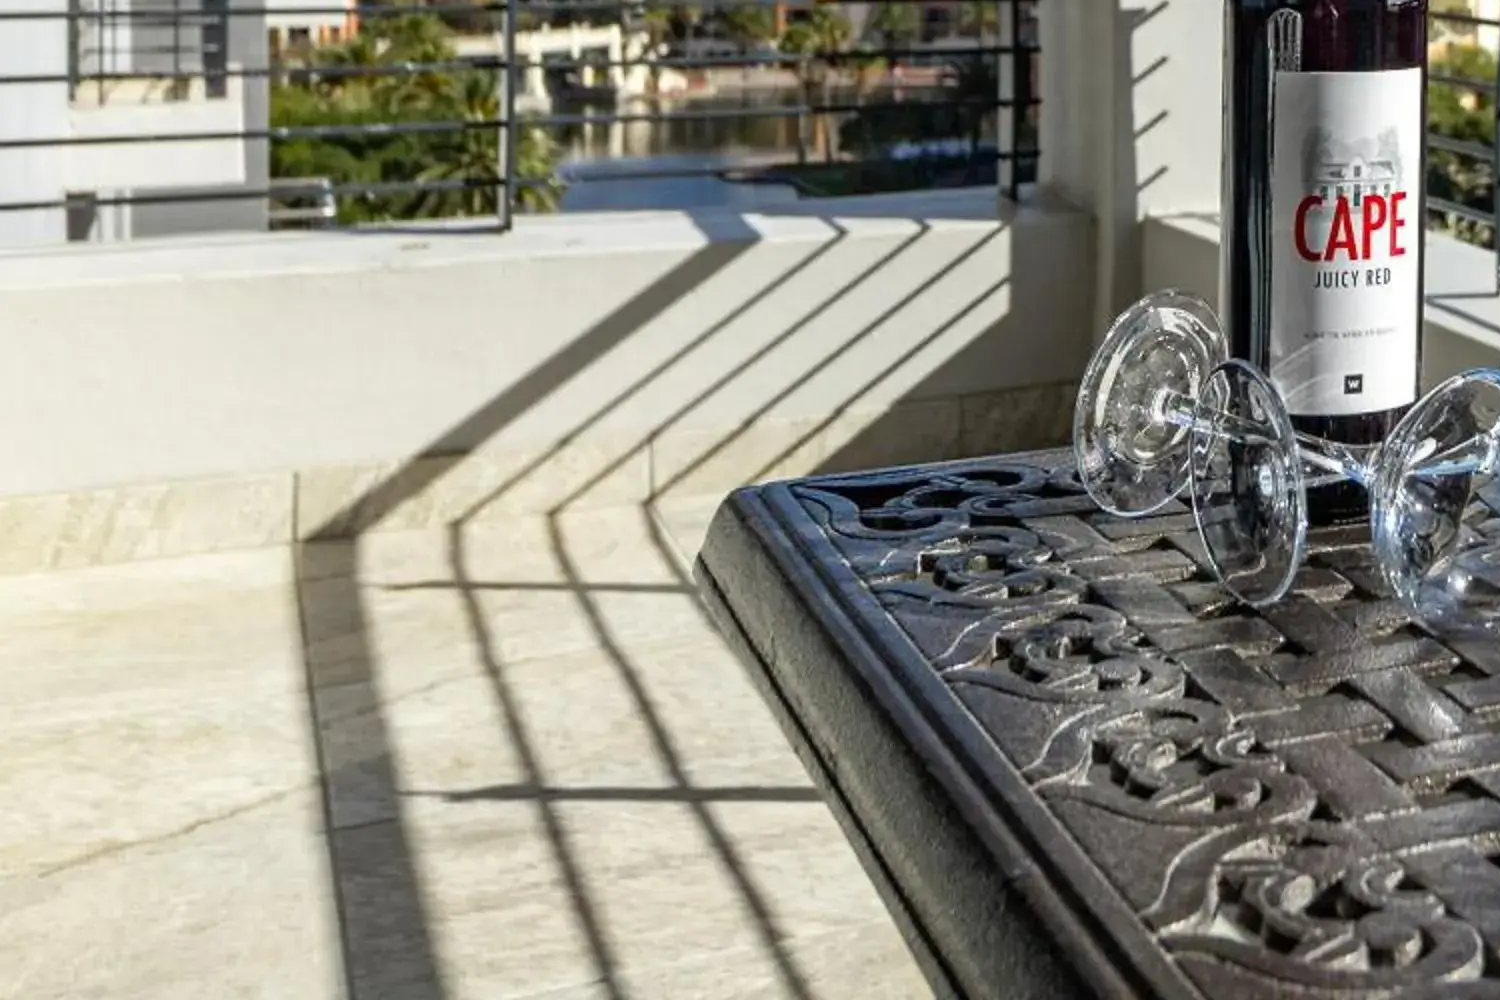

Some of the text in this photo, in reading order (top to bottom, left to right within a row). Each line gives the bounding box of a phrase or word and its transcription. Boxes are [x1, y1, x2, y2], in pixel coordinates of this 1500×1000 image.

[1294, 191, 1406, 262] CAPE
[1314, 267, 1391, 288] JUICY RED
